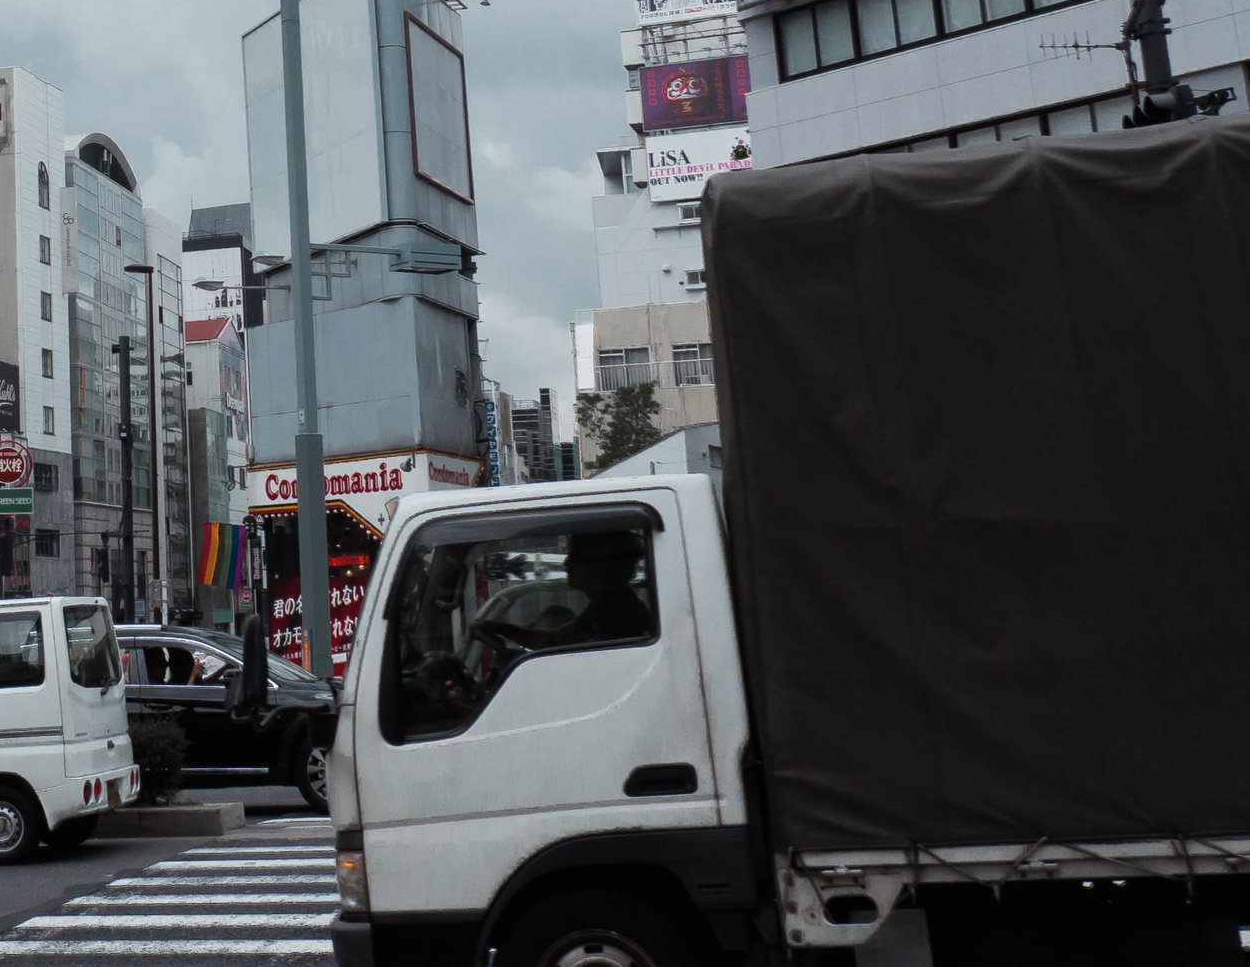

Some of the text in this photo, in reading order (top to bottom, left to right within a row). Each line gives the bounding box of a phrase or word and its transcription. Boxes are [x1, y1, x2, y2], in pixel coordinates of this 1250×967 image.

[718, 159, 752, 170] PARAD
[650, 176, 670, 186] OUT
[265, 462, 403, 501] Conomania
[15, 497, 33, 505] SEED
